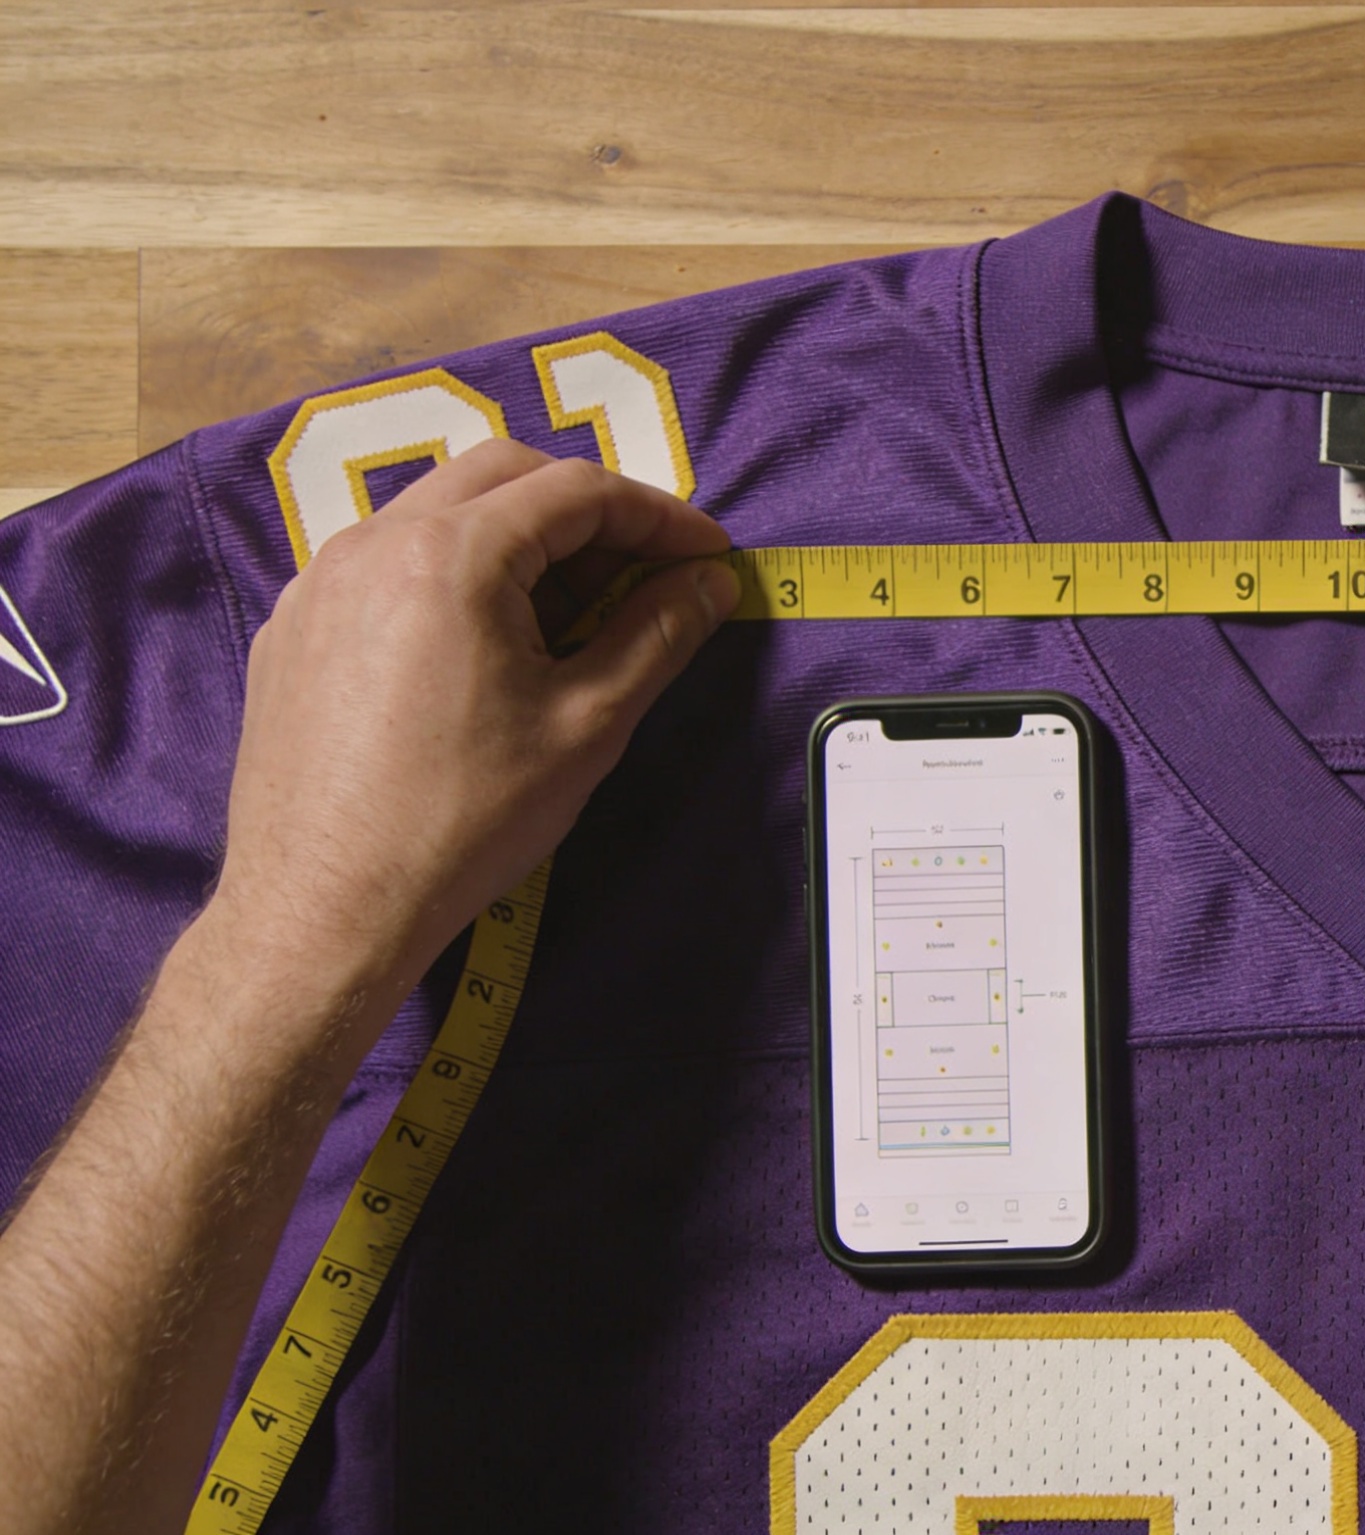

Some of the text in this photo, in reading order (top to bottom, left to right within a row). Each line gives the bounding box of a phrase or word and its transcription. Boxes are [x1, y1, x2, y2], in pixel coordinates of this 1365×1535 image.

[777, 579, 799, 607] 3
[869, 577, 890, 606] 4
[960, 575, 981, 604] 6
[1051, 574, 1072, 603] 7
[1142, 574, 1164, 602] 8
[1233, 572, 1255, 600] 9
[467, 979, 494, 1004] 2
[362, 1190, 391, 1214] 6
[322, 1264, 352, 1289] 5
[283, 1335, 312, 1358] 7
[251, 1407, 279, 1432] 4
